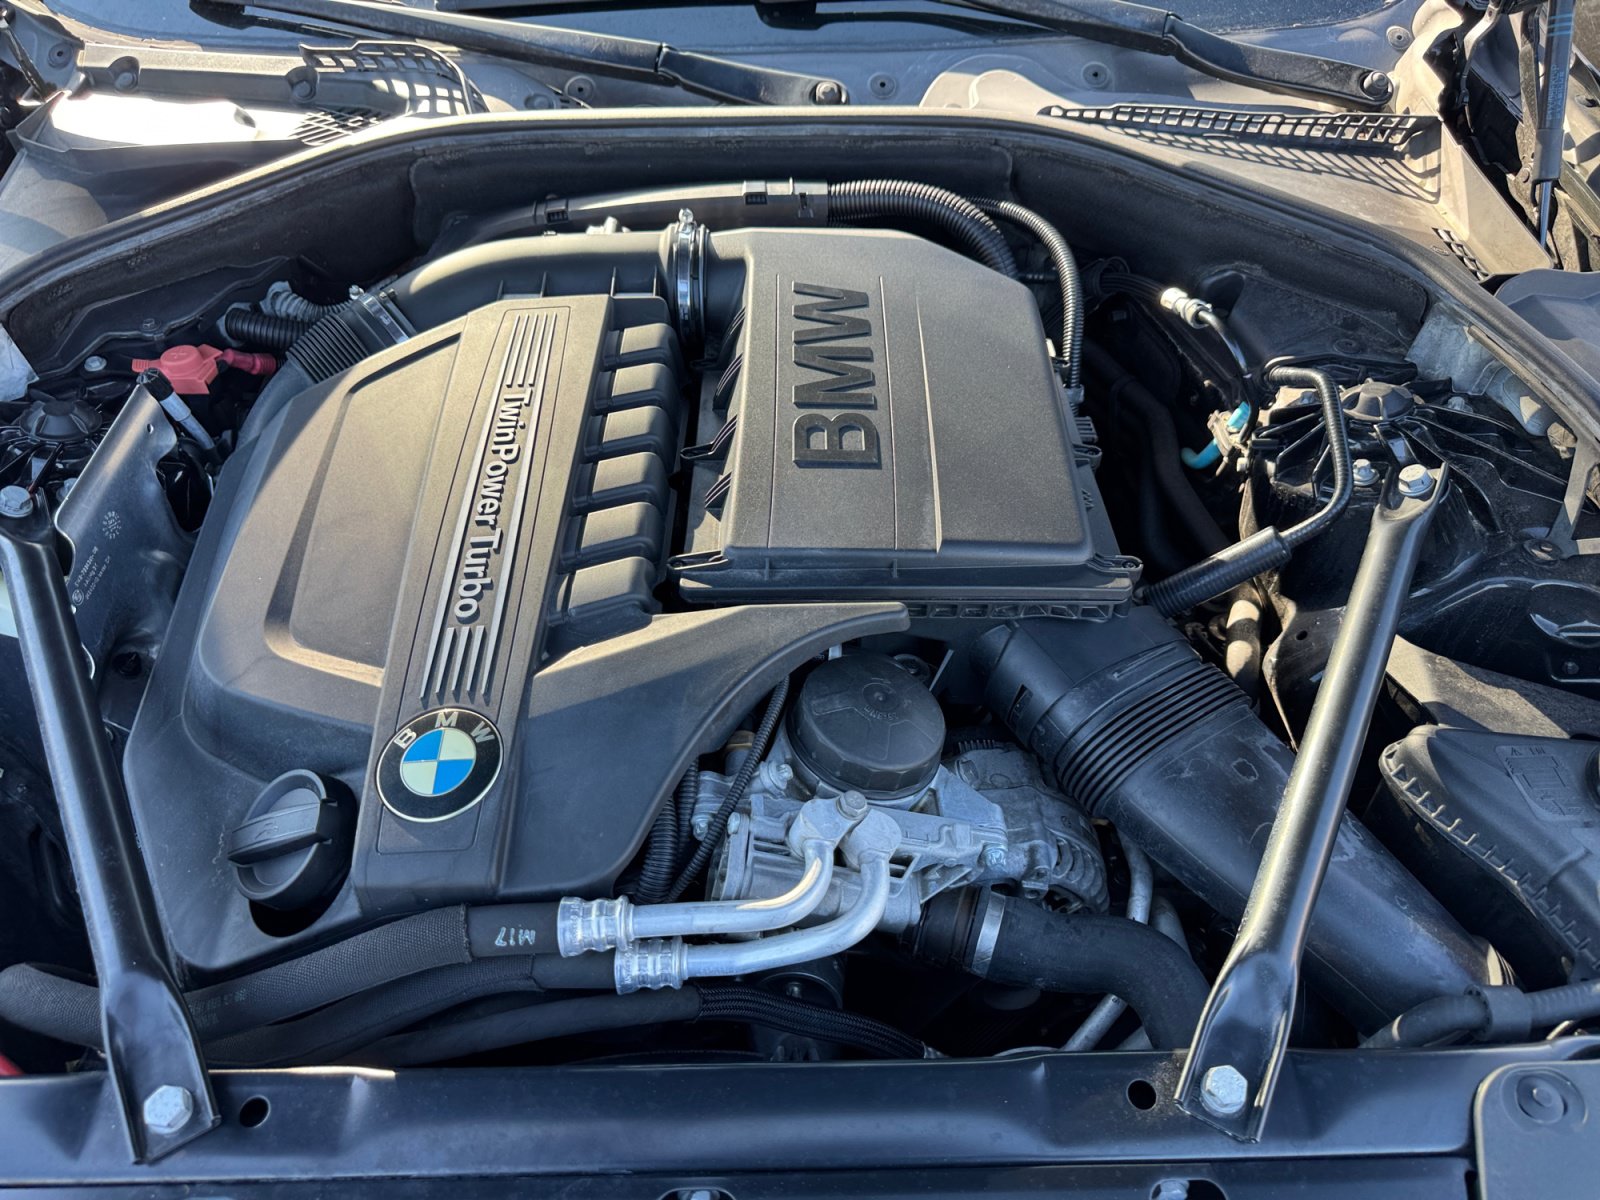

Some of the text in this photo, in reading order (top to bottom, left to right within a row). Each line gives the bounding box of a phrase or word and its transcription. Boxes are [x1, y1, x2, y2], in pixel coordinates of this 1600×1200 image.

[791, 280, 881, 469] BMW
[453, 386, 533, 624] TwinPower Turbo
[393, 711, 496, 750] BMW
